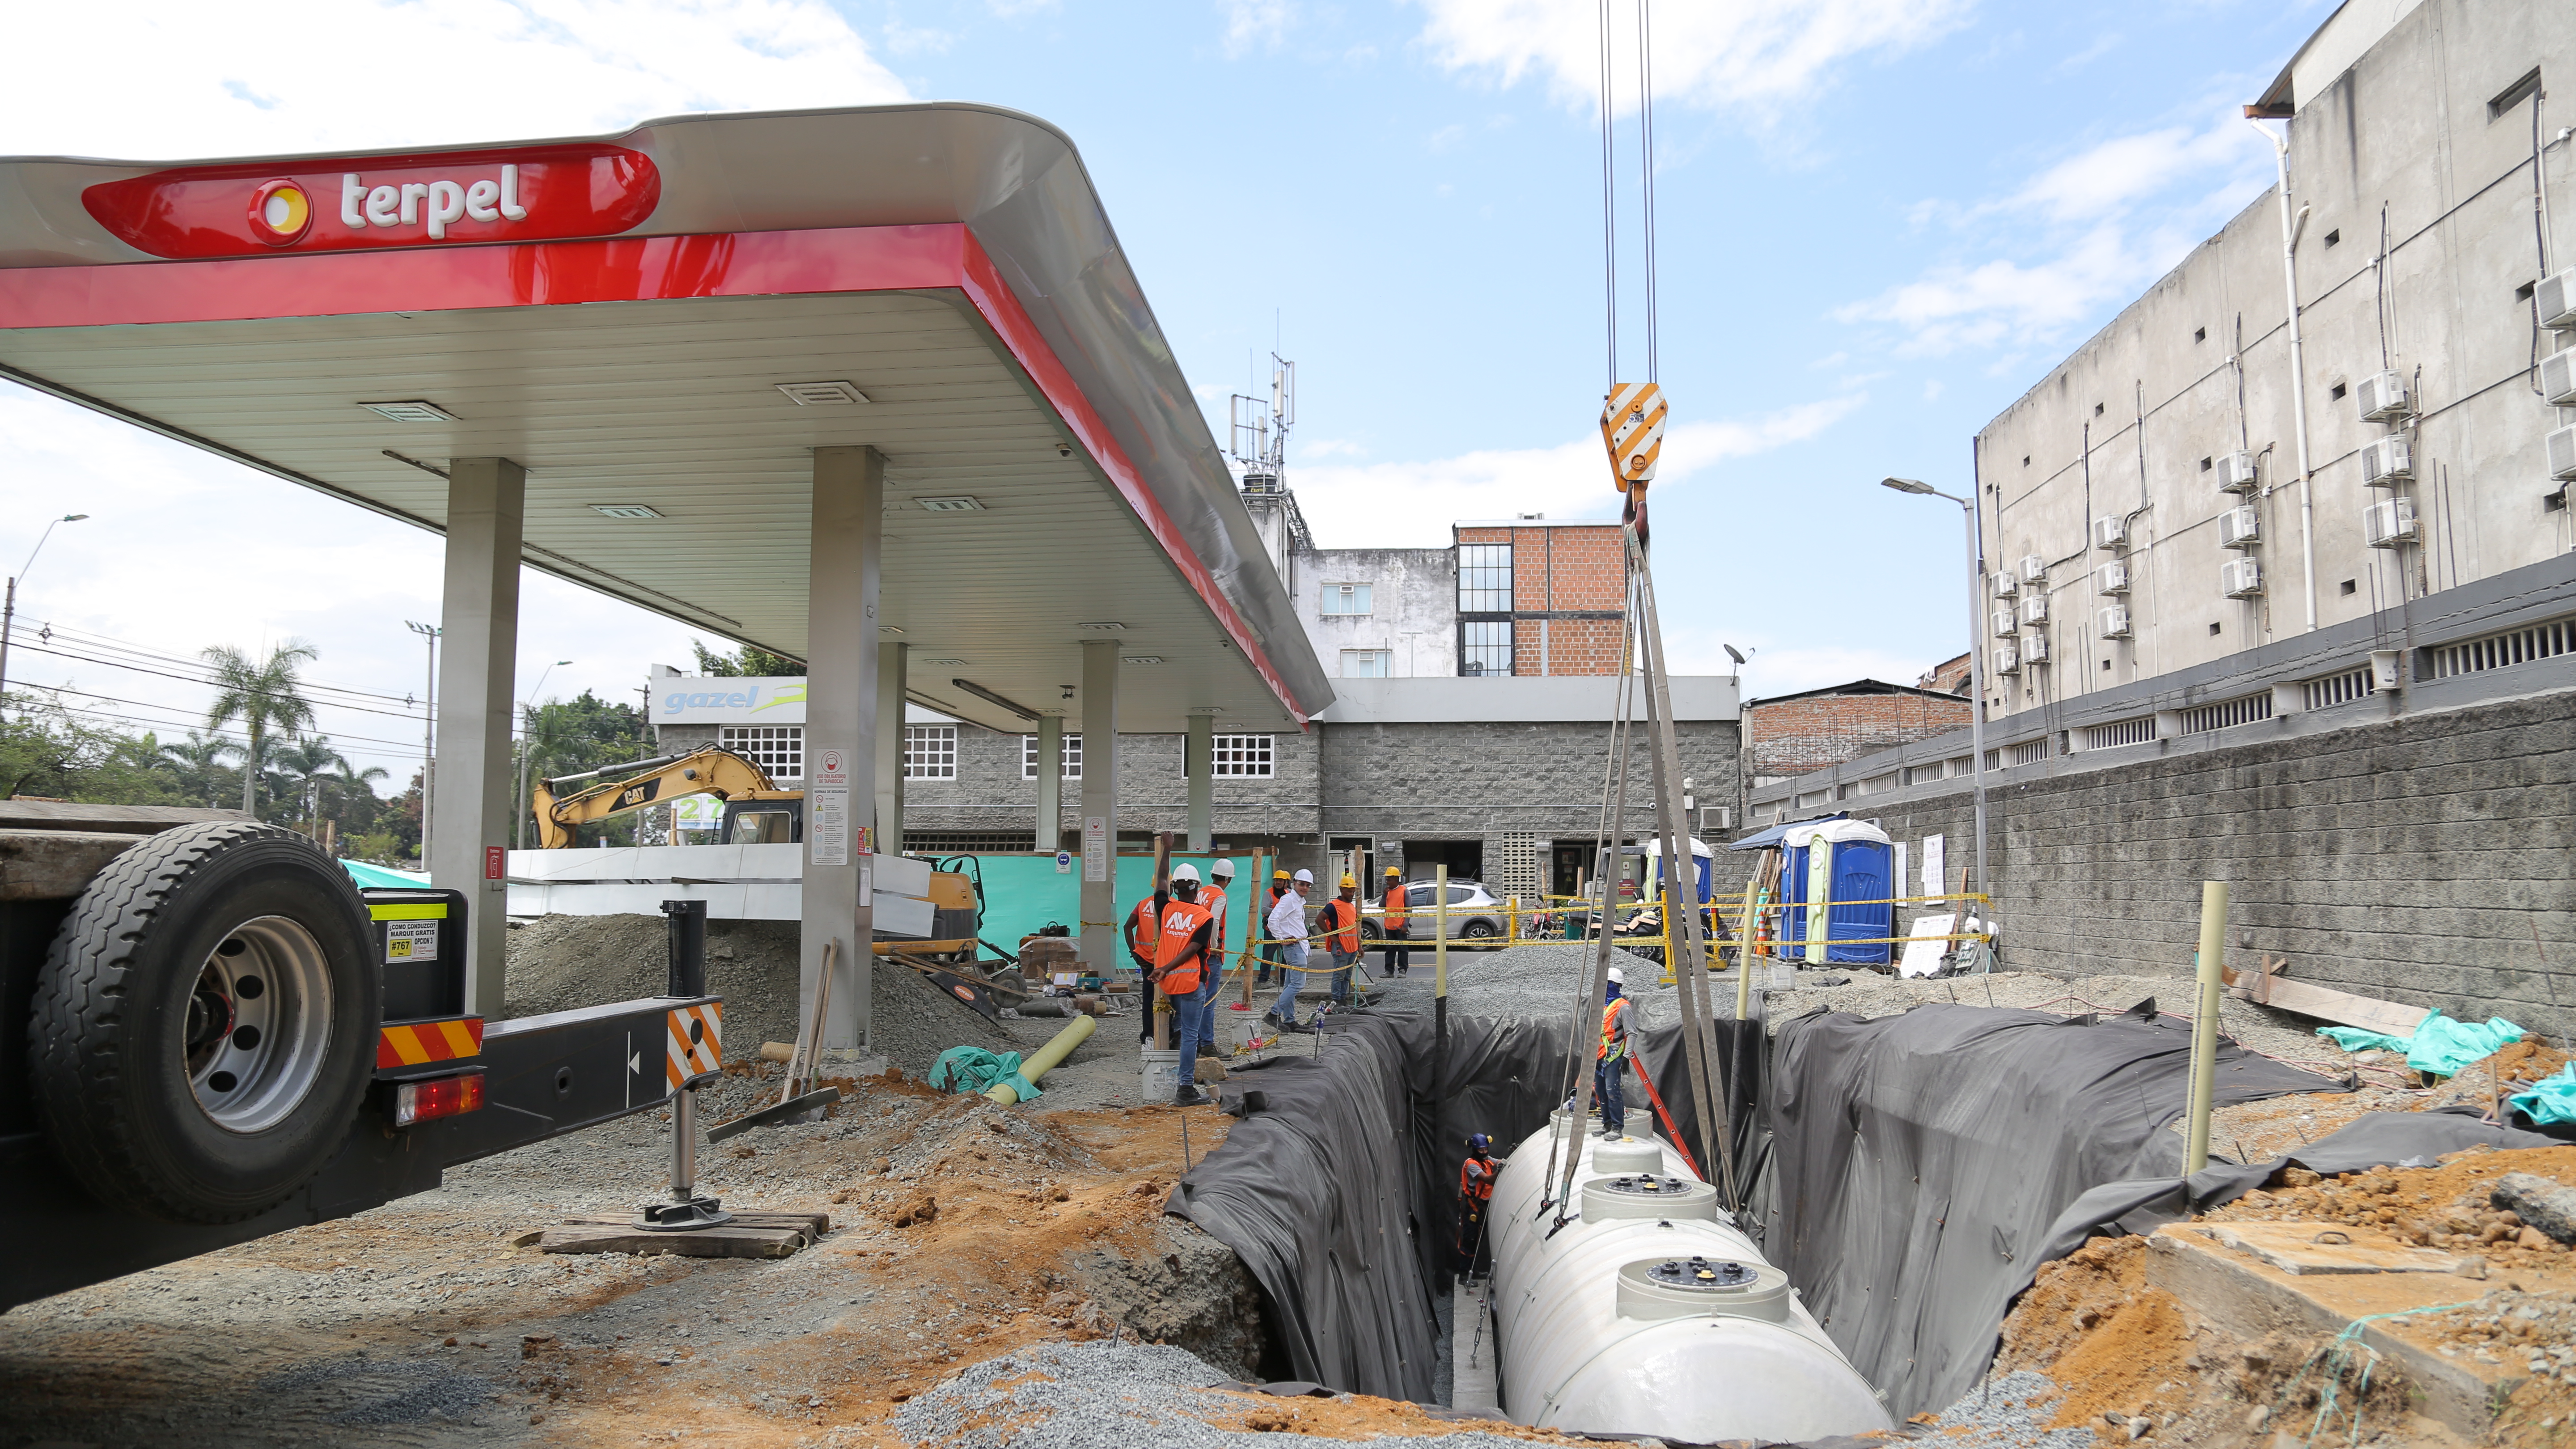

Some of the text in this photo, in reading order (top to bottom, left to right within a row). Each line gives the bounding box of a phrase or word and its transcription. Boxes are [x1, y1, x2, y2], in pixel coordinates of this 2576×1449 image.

[341, 164, 527, 239] terpel
[664, 686, 759, 715] gazel
[624, 786, 645, 805] CAT
[391, 941, 410, 951] #767
[955, 987, 974, 1000] HERRAGRO
